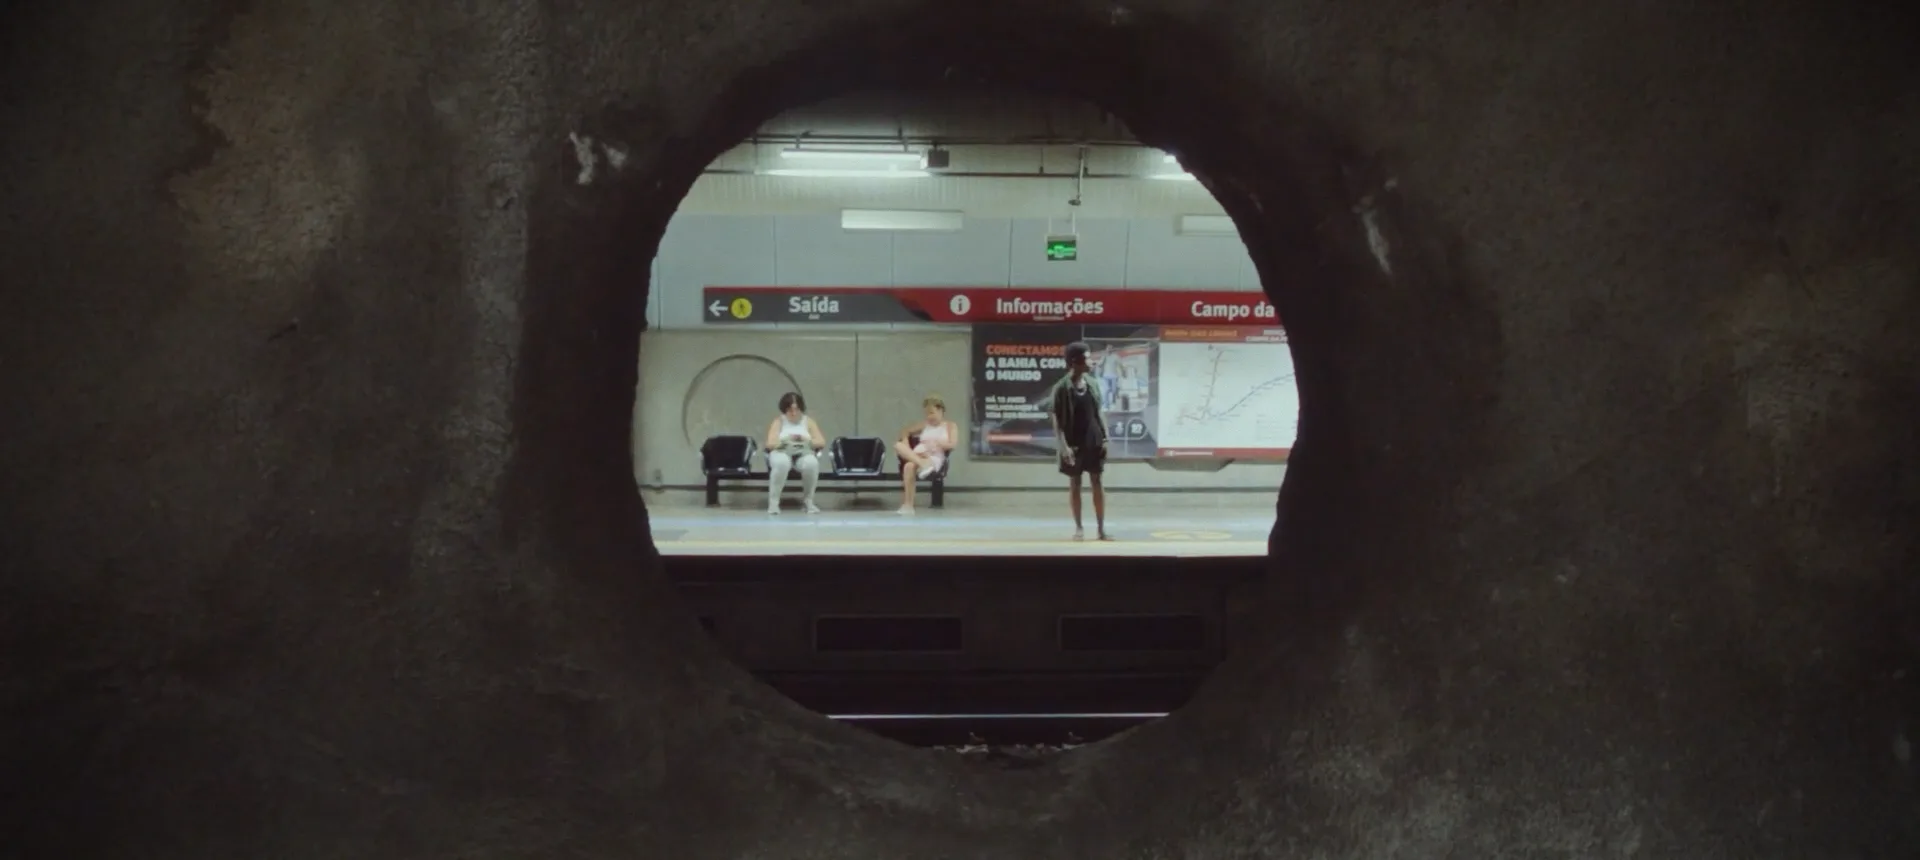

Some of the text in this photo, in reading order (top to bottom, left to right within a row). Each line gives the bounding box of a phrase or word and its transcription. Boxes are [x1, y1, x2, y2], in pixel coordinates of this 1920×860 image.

[789, 295, 839, 313] Saída
[996, 297, 1104, 317] Informações
[1191, 301, 1275, 321] Campo da
[985, 357, 1067, 369] A BAHIA COM
[985, 369, 1042, 381] O MUNDO
